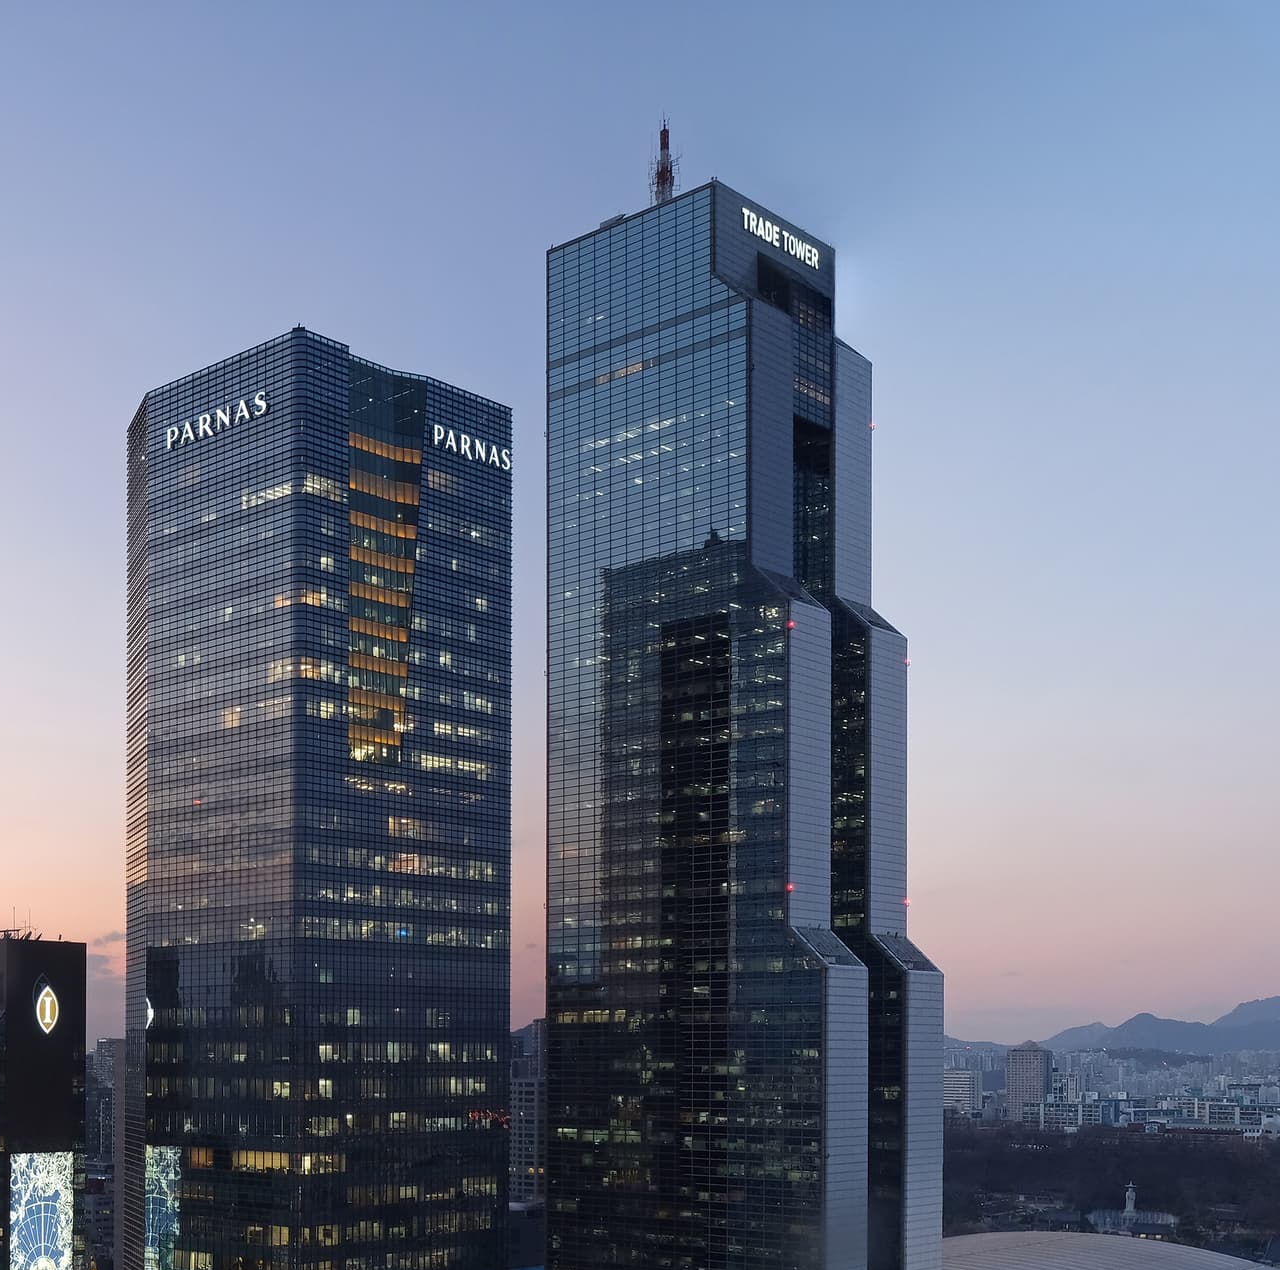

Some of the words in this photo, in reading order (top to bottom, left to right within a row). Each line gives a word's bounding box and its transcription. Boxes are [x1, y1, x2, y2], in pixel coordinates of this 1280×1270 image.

[742, 207, 780, 247] TRADE
[782, 230, 819, 270] TOWER
[165, 391, 270, 450] PARNAS
[434, 424, 512, 471] PARNAS
